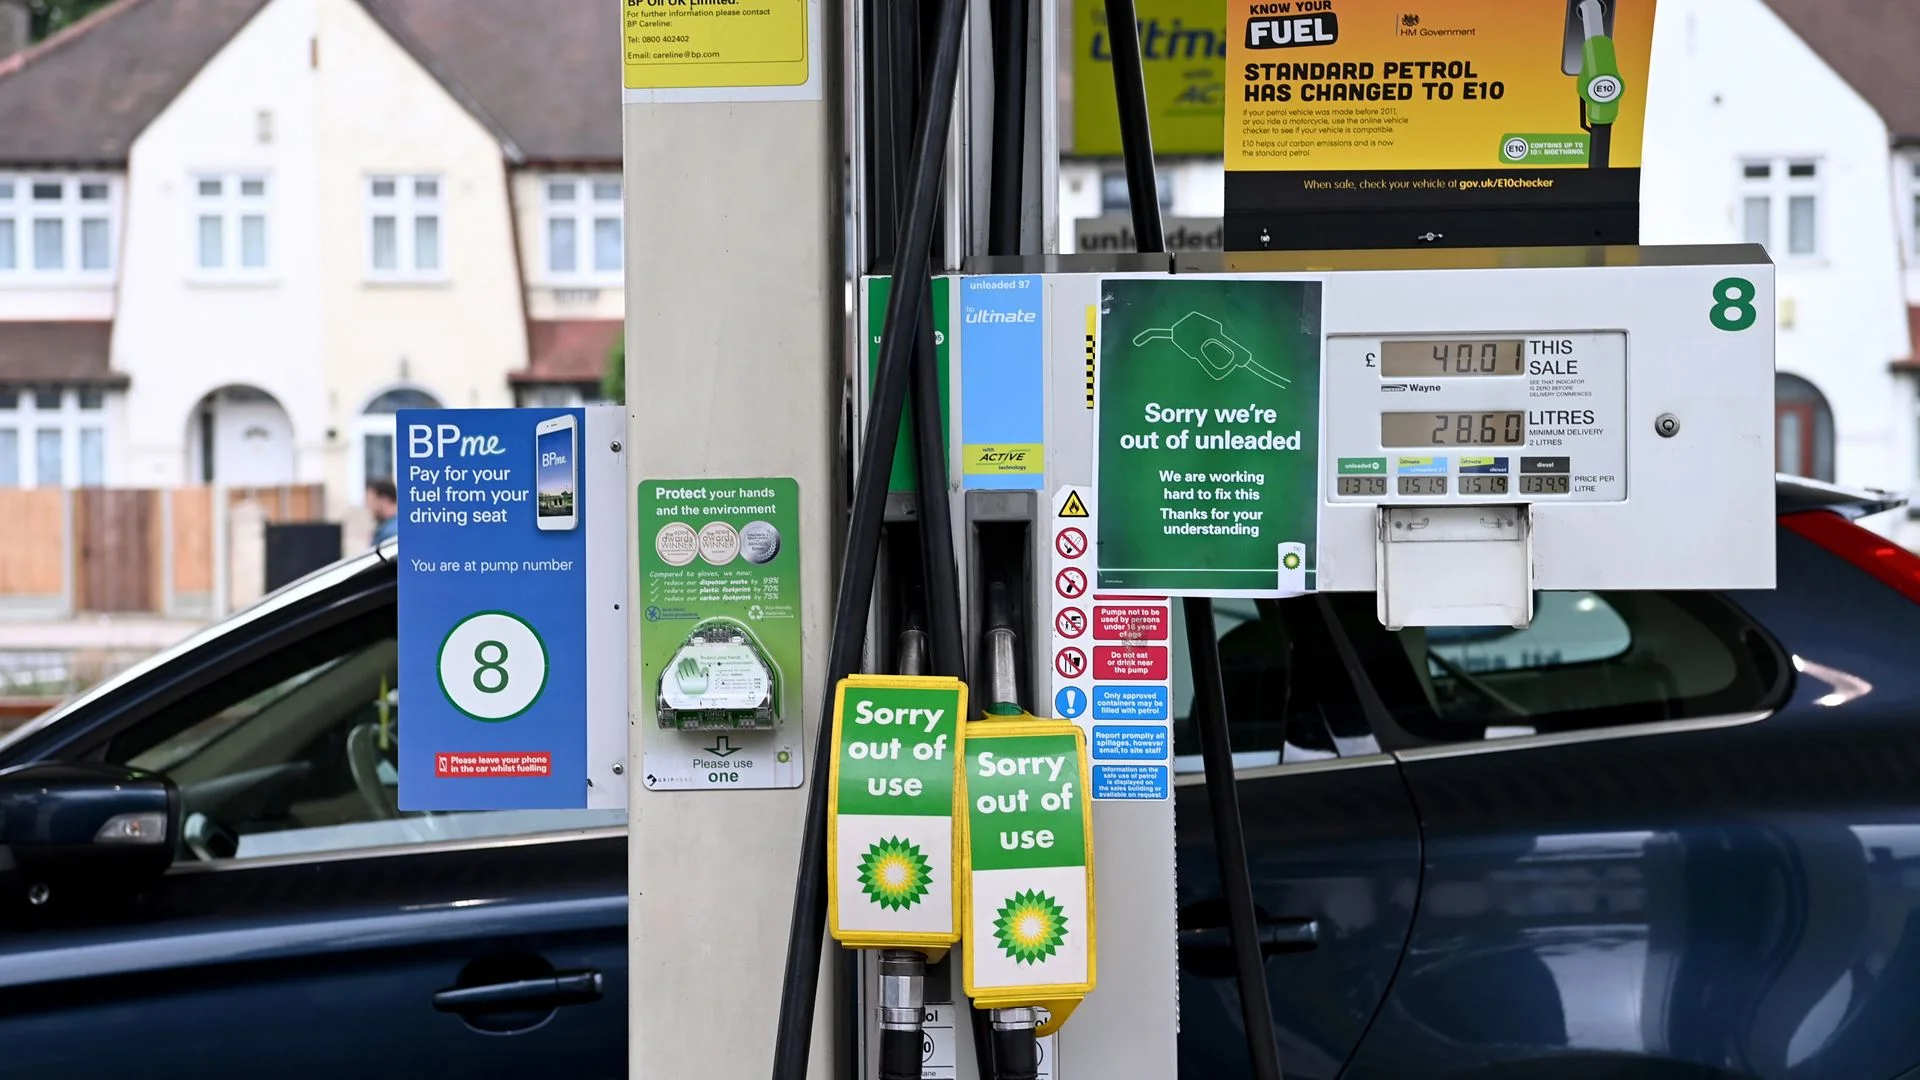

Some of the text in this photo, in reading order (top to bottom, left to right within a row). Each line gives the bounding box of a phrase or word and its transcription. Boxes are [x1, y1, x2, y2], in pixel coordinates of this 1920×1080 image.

[640, 10, 666, 18] further
[1250, 0, 1332, 15] KNOW YOUR
[1250, 18, 1334, 46] FUEL
[1400, 27, 1476, 37] HM Government
[627, 36, 640, 44] Tel:
[1244, 61, 1477, 81] STANDARD PETROL
[1244, 83, 1292, 102] HAS
[1300, 83, 1412, 101] CHANGED
[1421, 82, 1453, 100] TO
[1462, 81, 1505, 100] E10
[1595, 84, 1613, 93] E10
[1249, 110, 1264, 118] your
[1266, 108, 1287, 117] petrol
[1288, 108, 1313, 116] vehicle
[1331, 108, 1353, 116] made
[1508, 144, 1524, 153] E10
[1304, 178, 1554, 190] When safe, check your vehicle at gov.uk/E10checker
[970, 280, 1030, 290] unleaded 97
[1709, 277, 1757, 331] 8
[965, 308, 1036, 324] ultimate
[1529, 340, 1573, 355] THIS
[1365, 344, 1520, 373] £ 40.01
[1529, 360, 1578, 375] SALE
[1409, 383, 1441, 393] Wayne
[1144, 402, 1277, 428] Sorry we're
[1529, 410, 1595, 425] LITRES
[1432, 414, 1521, 444] 28.60
[1120, 430, 1301, 451] out of unleaded
[979, 452, 1025, 462] ACTIVE
[409, 465, 511, 484] Pay for your
[1159, 471, 1265, 485] We are working
[1599, 475, 1615, 483] PER
[1345, 478, 1385, 493] 137.9
[1406, 478, 1445, 493] 151.9
[1466, 477, 1506, 492] 151.9
[409, 486, 529, 505] fuel from your
[655, 487, 775, 500] Protect your hands
[1163, 488, 1260, 500] hard to fix this
[409, 507, 508, 526] driving seat
[656, 504, 776, 516] and the environment
[1160, 508, 1263, 522] Thanks for your
[1163, 523, 1260, 537] understanding
[411, 559, 573, 574] You are at pump number
[1101, 608, 1126, 616] Pumps
[1119, 616, 1129, 624] by
[472, 640, 509, 694] 8
[1127, 667, 1149, 675] pump
[1103, 692, 1157, 700] Only approved
[854, 700, 944, 733] Sorry
[1138, 707, 1159, 715] petrol
[848, 734, 947, 760] out of
[450, 756, 547, 766] Please leave your phone
[692, 758, 753, 769] Please use
[977, 751, 1065, 782] Sorry
[450, 765, 458, 773] in
[459, 765, 474, 773] the
[489, 764, 516, 772] whilst
[516, 764, 547, 774] fuelling
[708, 771, 739, 783] one
[868, 777, 923, 797] use
[976, 783, 1073, 813] out of
[1000, 832, 1054, 850] use
